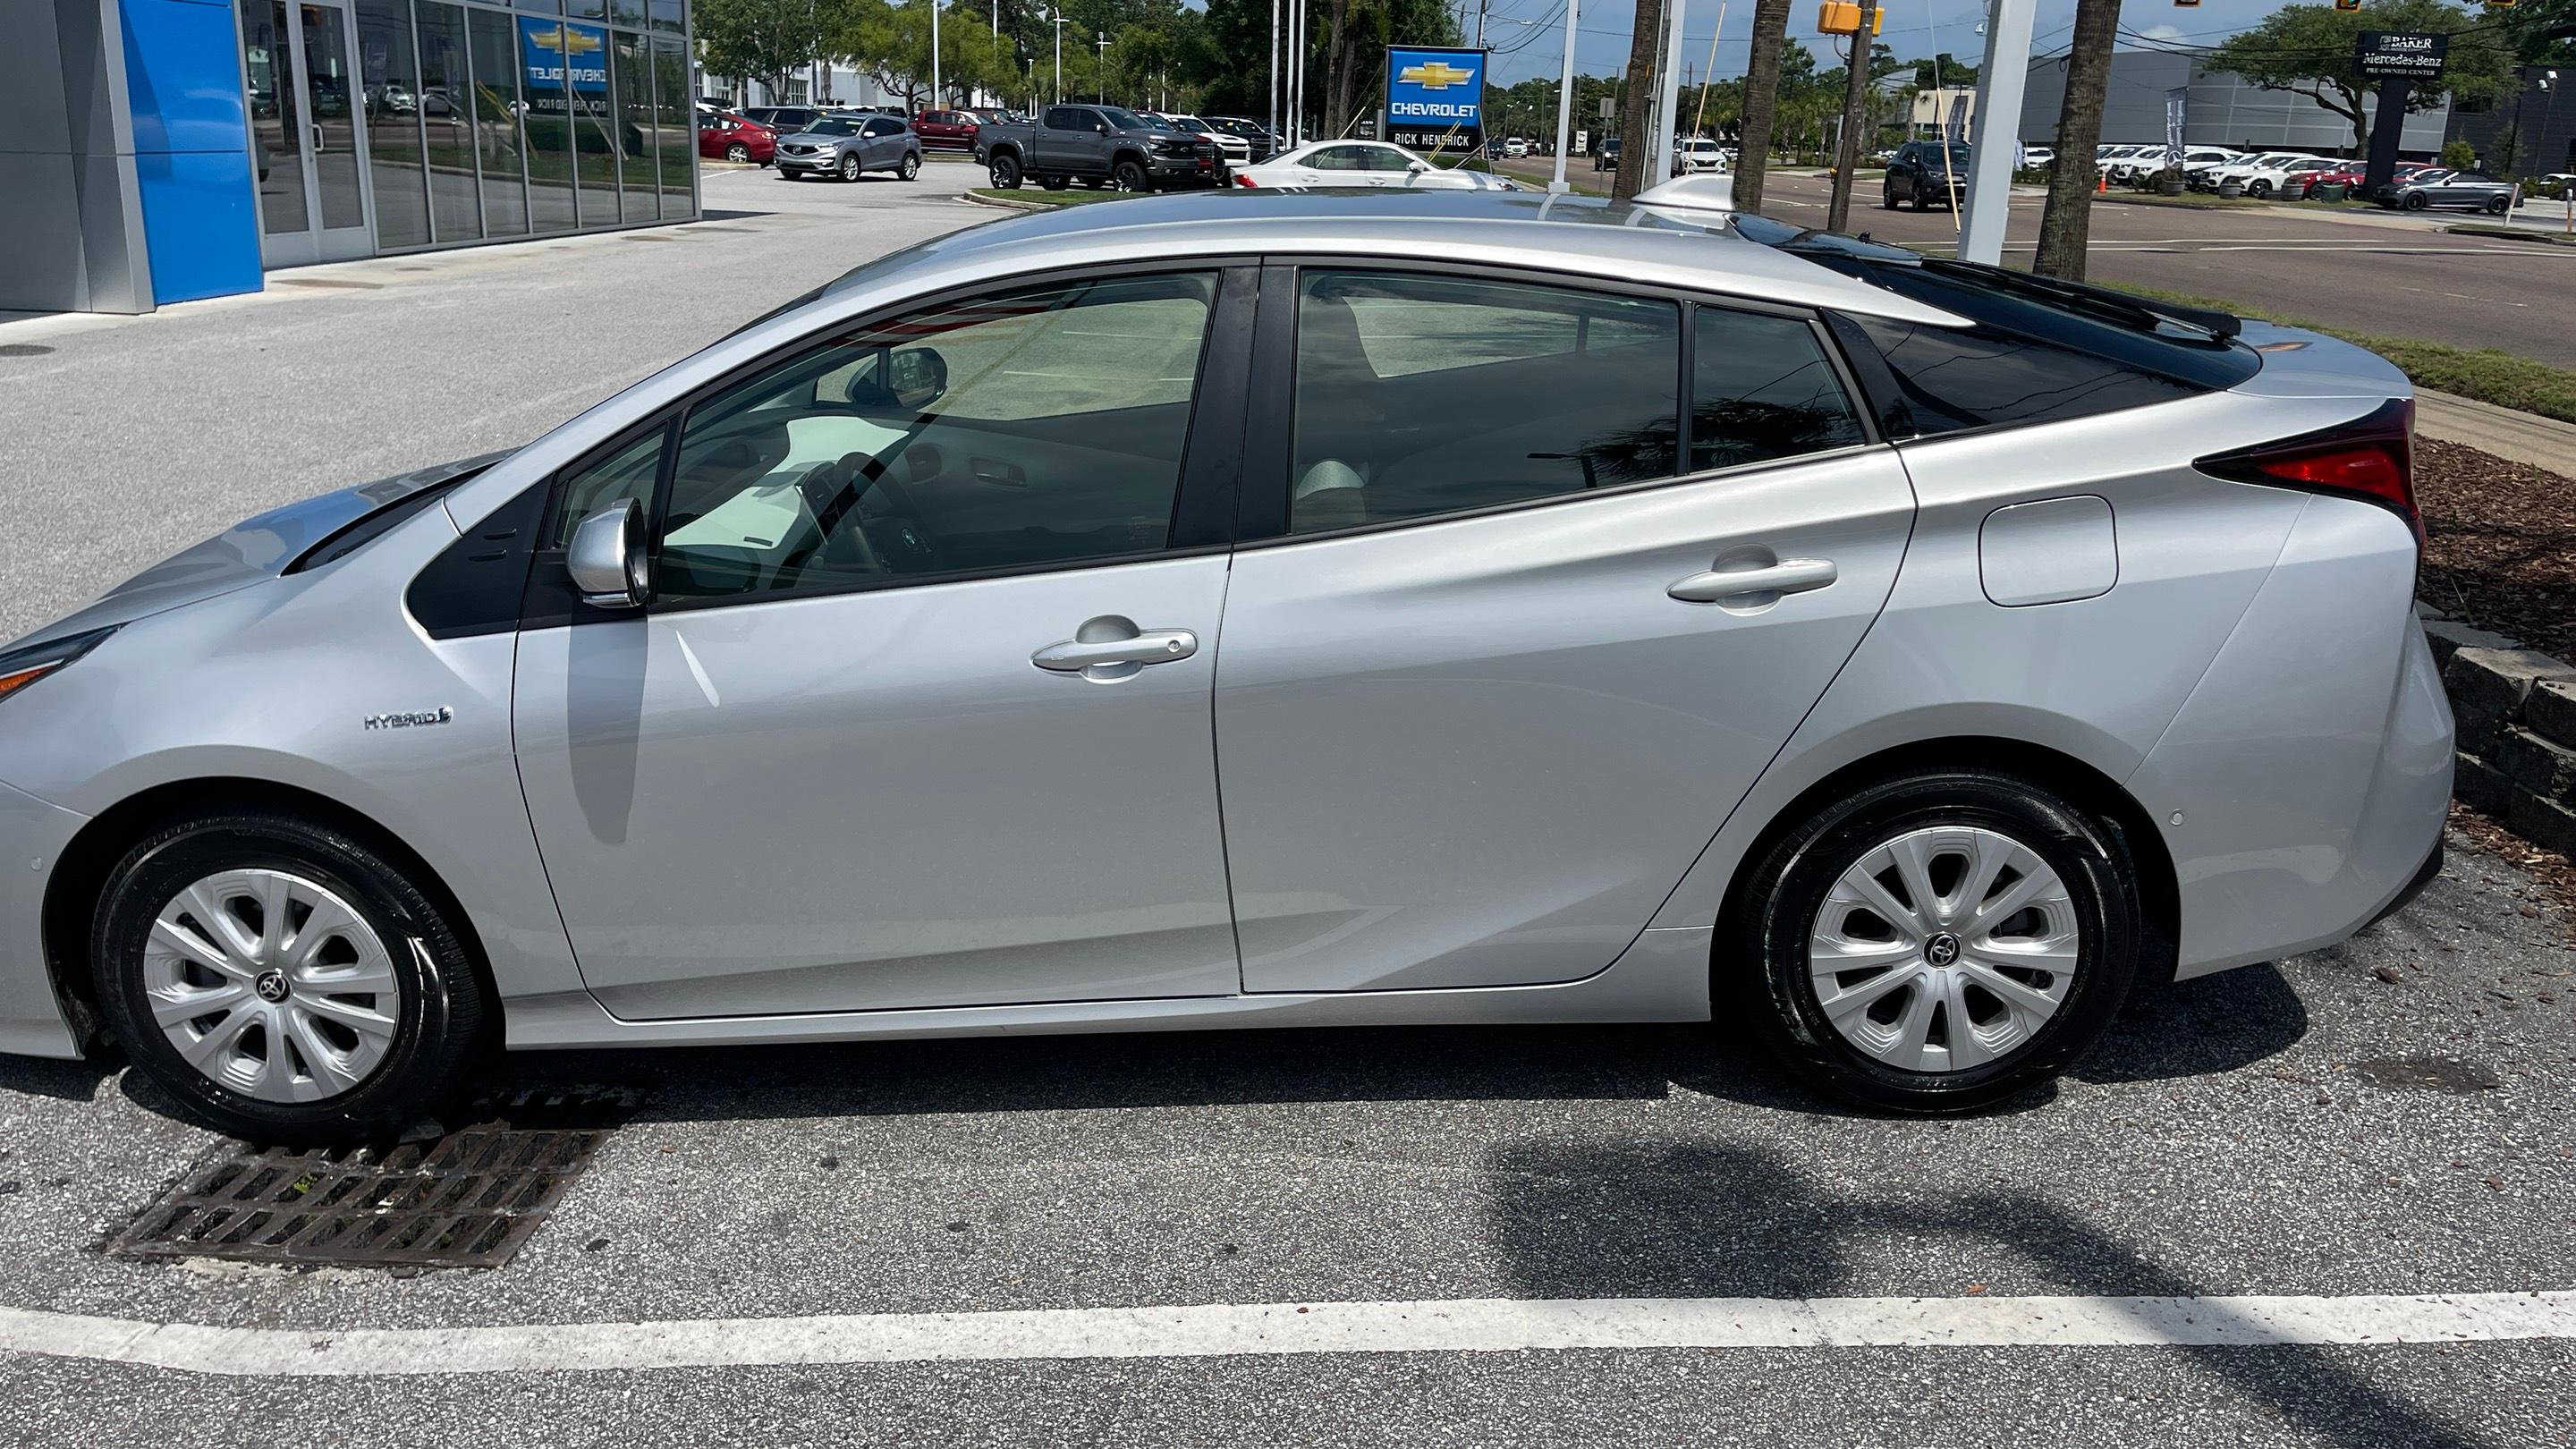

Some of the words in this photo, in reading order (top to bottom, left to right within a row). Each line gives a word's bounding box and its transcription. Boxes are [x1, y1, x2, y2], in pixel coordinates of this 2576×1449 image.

[2391, 36, 2432, 49] BAKER
[2362, 53, 2442, 67] Mercedes-Benz
[1391, 102, 1477, 117] CHEVROLET
[1394, 133, 1418, 145] RICK
[1422, 134, 1470, 147] HENDRICK
[364, 712, 437, 730] HYBRID
